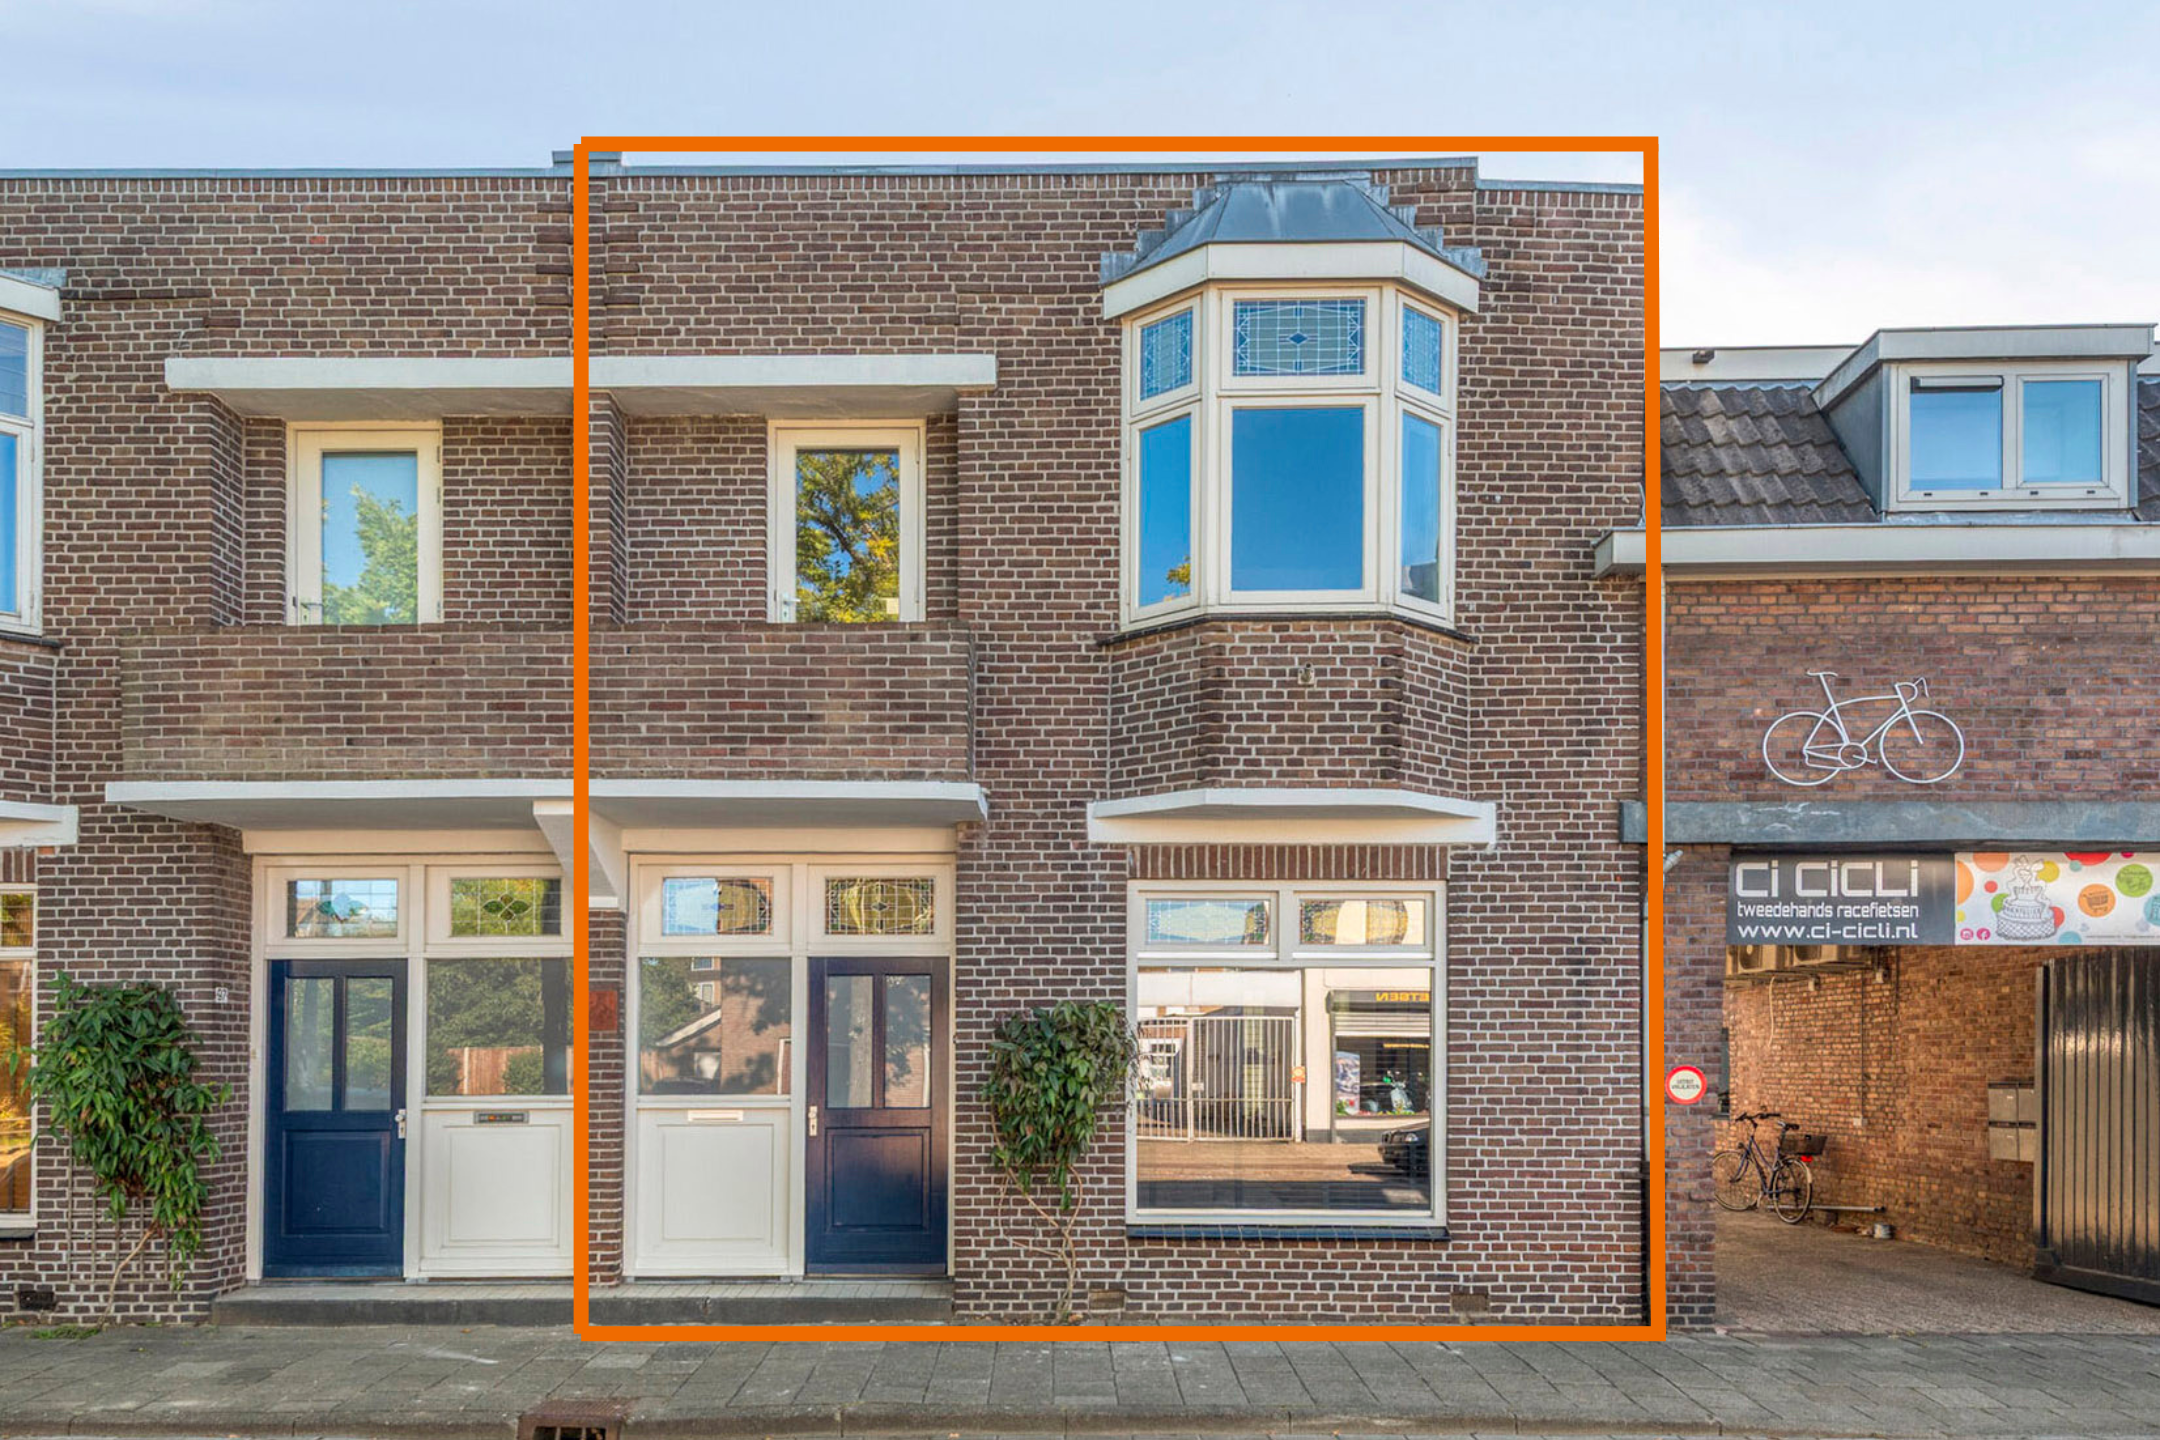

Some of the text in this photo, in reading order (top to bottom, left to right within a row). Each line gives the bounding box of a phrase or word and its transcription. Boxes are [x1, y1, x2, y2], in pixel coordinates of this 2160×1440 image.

[1737, 901, 1919, 918] tweedehands racefietsen
[1737, 922, 1919, 939] www.ci-cicli.nl
